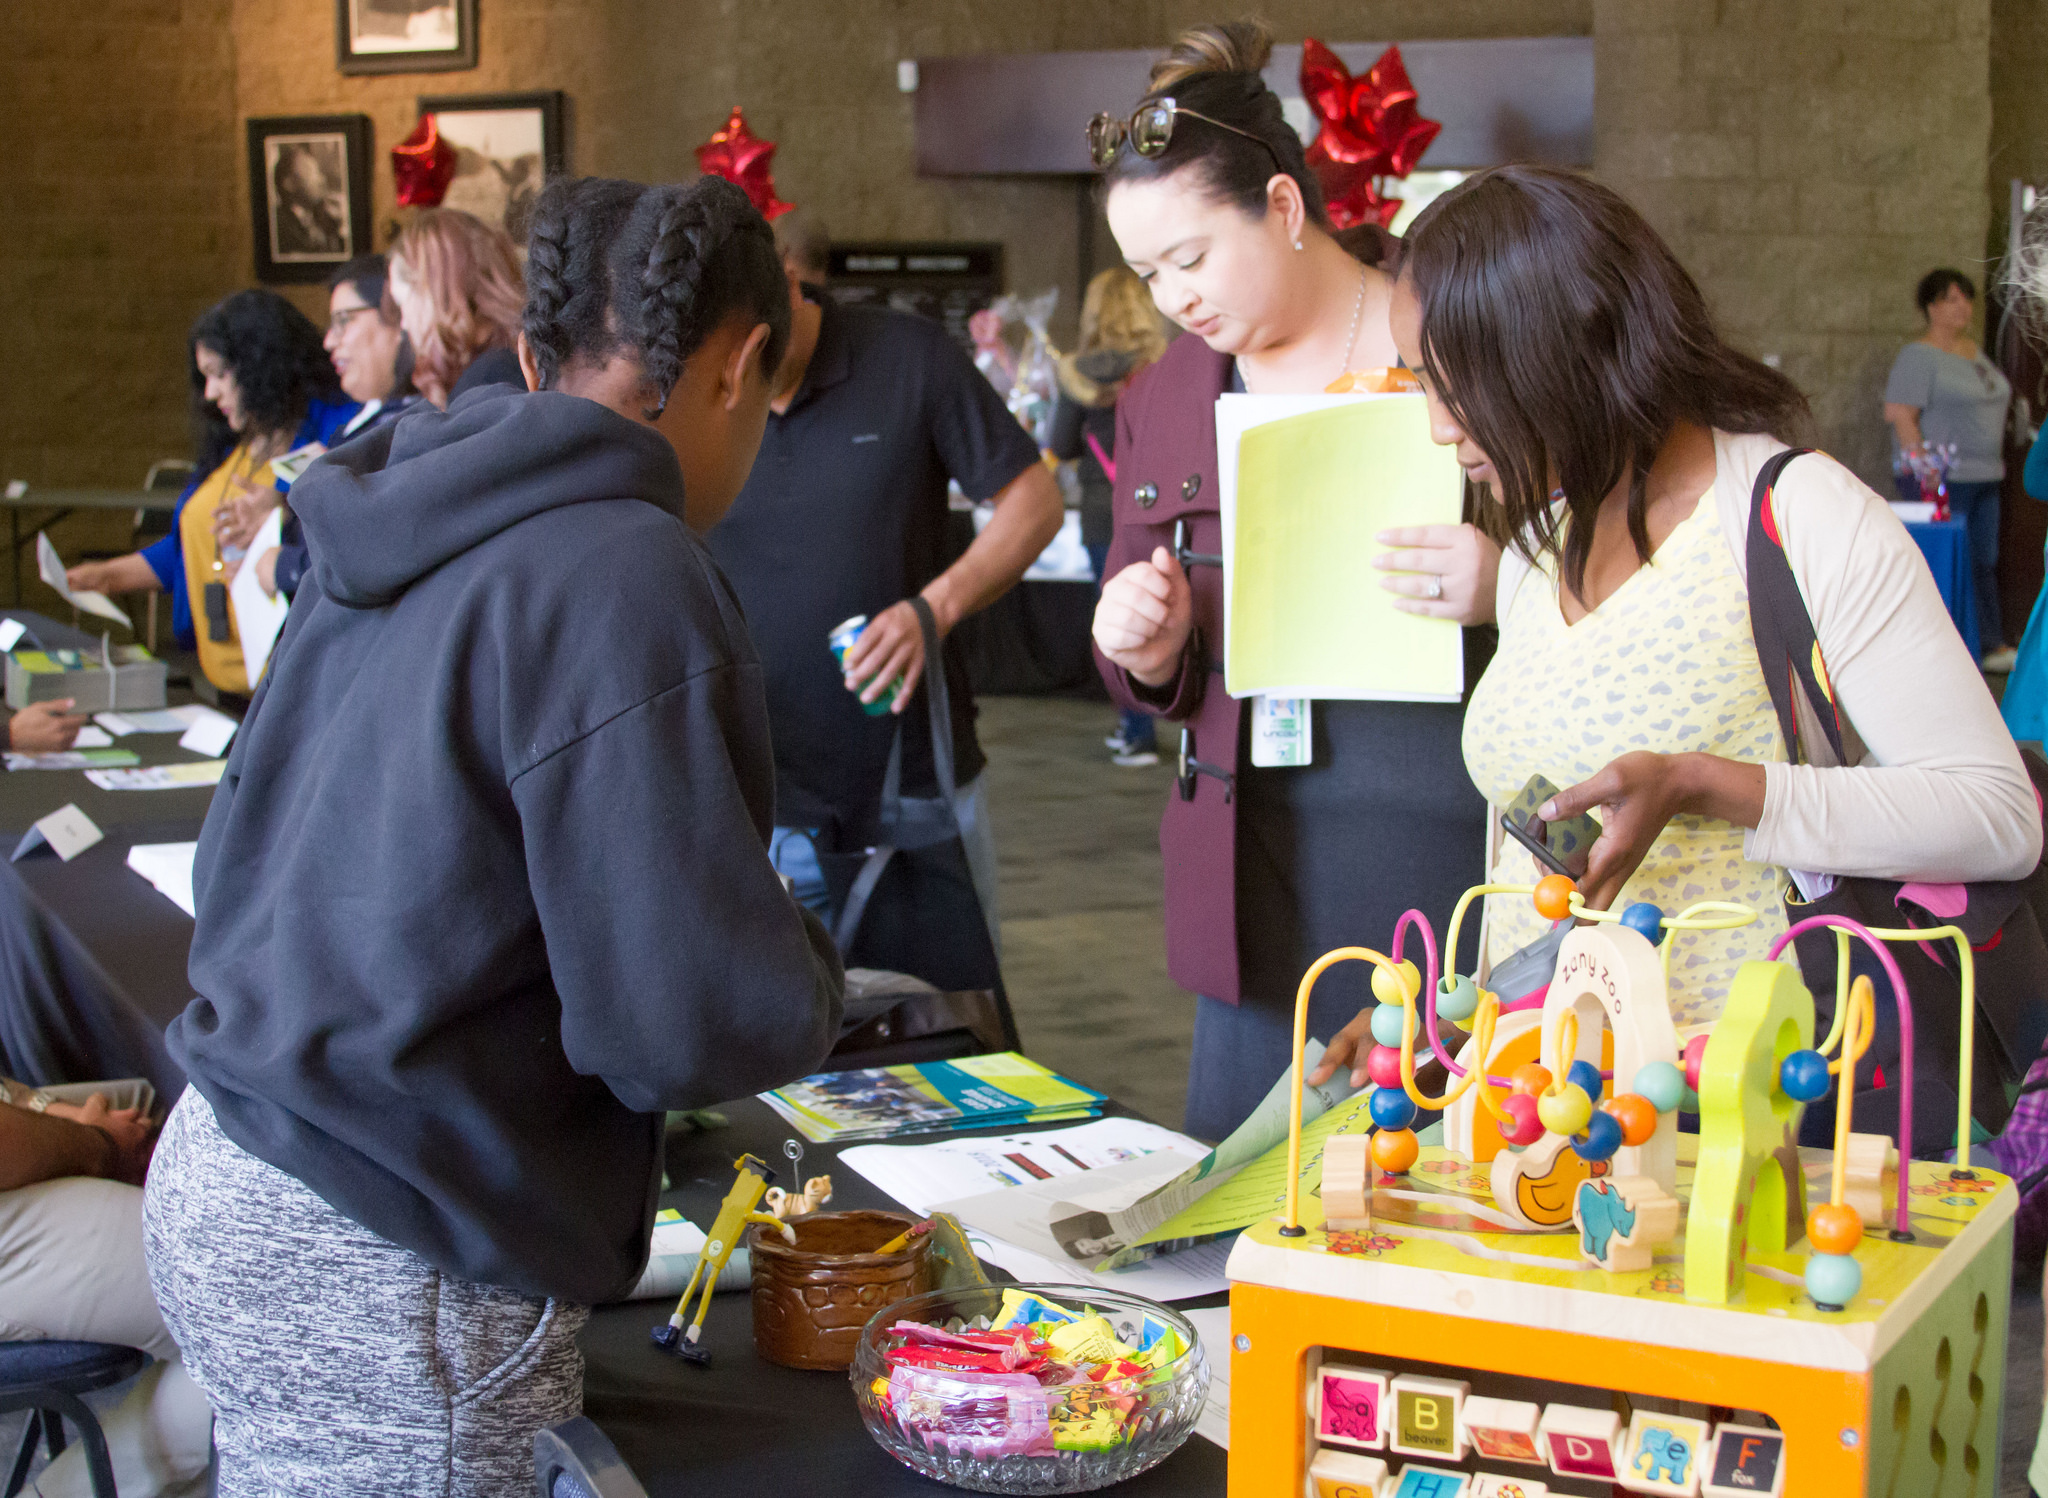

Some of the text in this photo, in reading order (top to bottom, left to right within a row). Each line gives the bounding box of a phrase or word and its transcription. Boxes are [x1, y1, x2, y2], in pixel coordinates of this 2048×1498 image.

[1562, 952, 1622, 1014] zany zoo
[1355, 1402, 1369, 1417] a
[1414, 1397, 1439, 1431] B
[1404, 1430, 1448, 1447] beaver
[1565, 1437, 1593, 1460] D
[1668, 1441, 1686, 1461] e
[1737, 1437, 1764, 1469] F
[1731, 1468, 1756, 1486] fox
